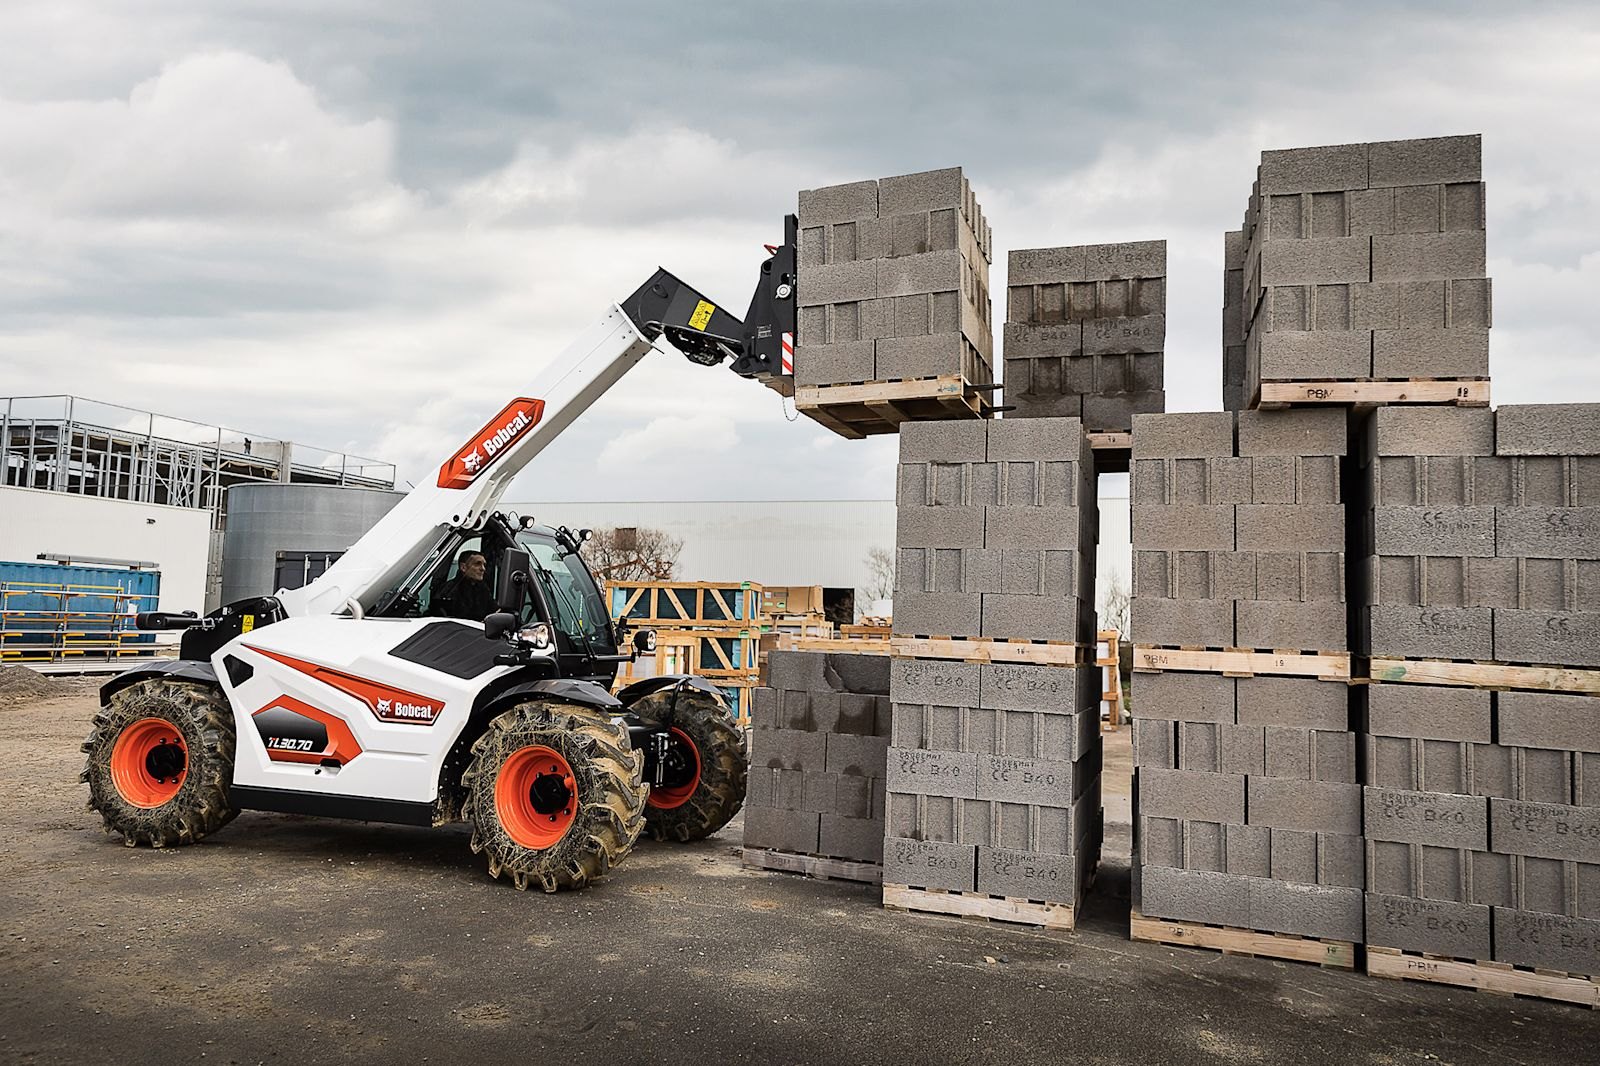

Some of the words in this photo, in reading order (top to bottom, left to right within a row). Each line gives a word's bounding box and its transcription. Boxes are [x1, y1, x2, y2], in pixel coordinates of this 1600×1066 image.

[1422, 511, 1443, 525] CE
[1546, 513, 1570, 527] CE
[1420, 611, 1441, 626] CE
[1546, 617, 1569, 631] CE
[1143, 654, 1169, 665] PBM
[268, 737, 313, 751] TL30.70
[992, 769, 1009, 782] CE
[1407, 960, 1438, 973] PBM
